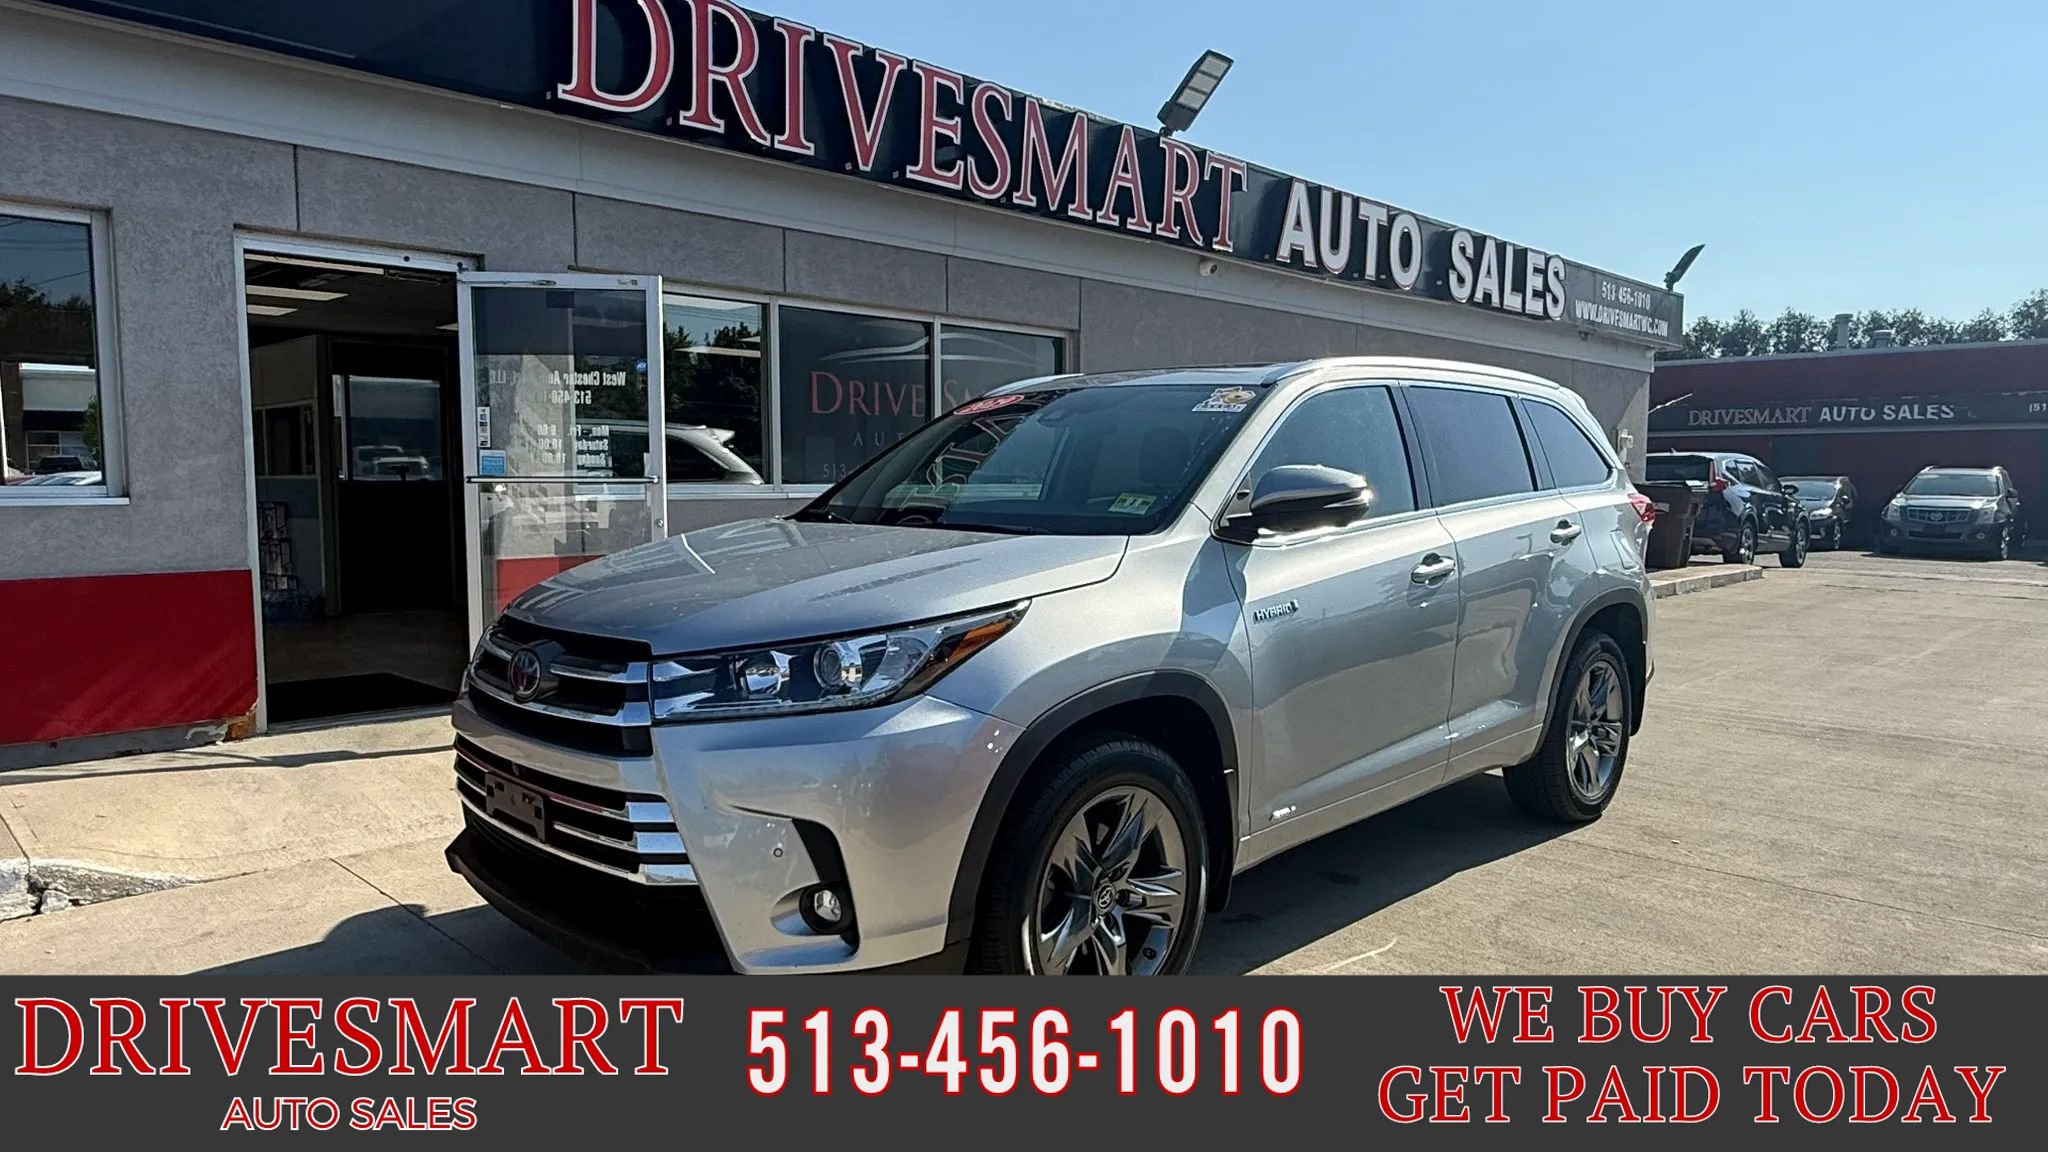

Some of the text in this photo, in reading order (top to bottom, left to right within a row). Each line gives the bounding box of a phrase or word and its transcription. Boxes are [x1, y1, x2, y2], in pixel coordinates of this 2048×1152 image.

[558, 0, 1567, 321] DRIVESMART AUTO SALES
[1601, 281, 1651, 310] 513 456-1010
[1688, 406, 1812, 426] DRIVESMART
[1819, 406, 1876, 422] AUTO
[1882, 404, 1955, 421] SALES
[2029, 403, 2048, 413] (51
[1254, 602, 1294, 620] HYBRID
